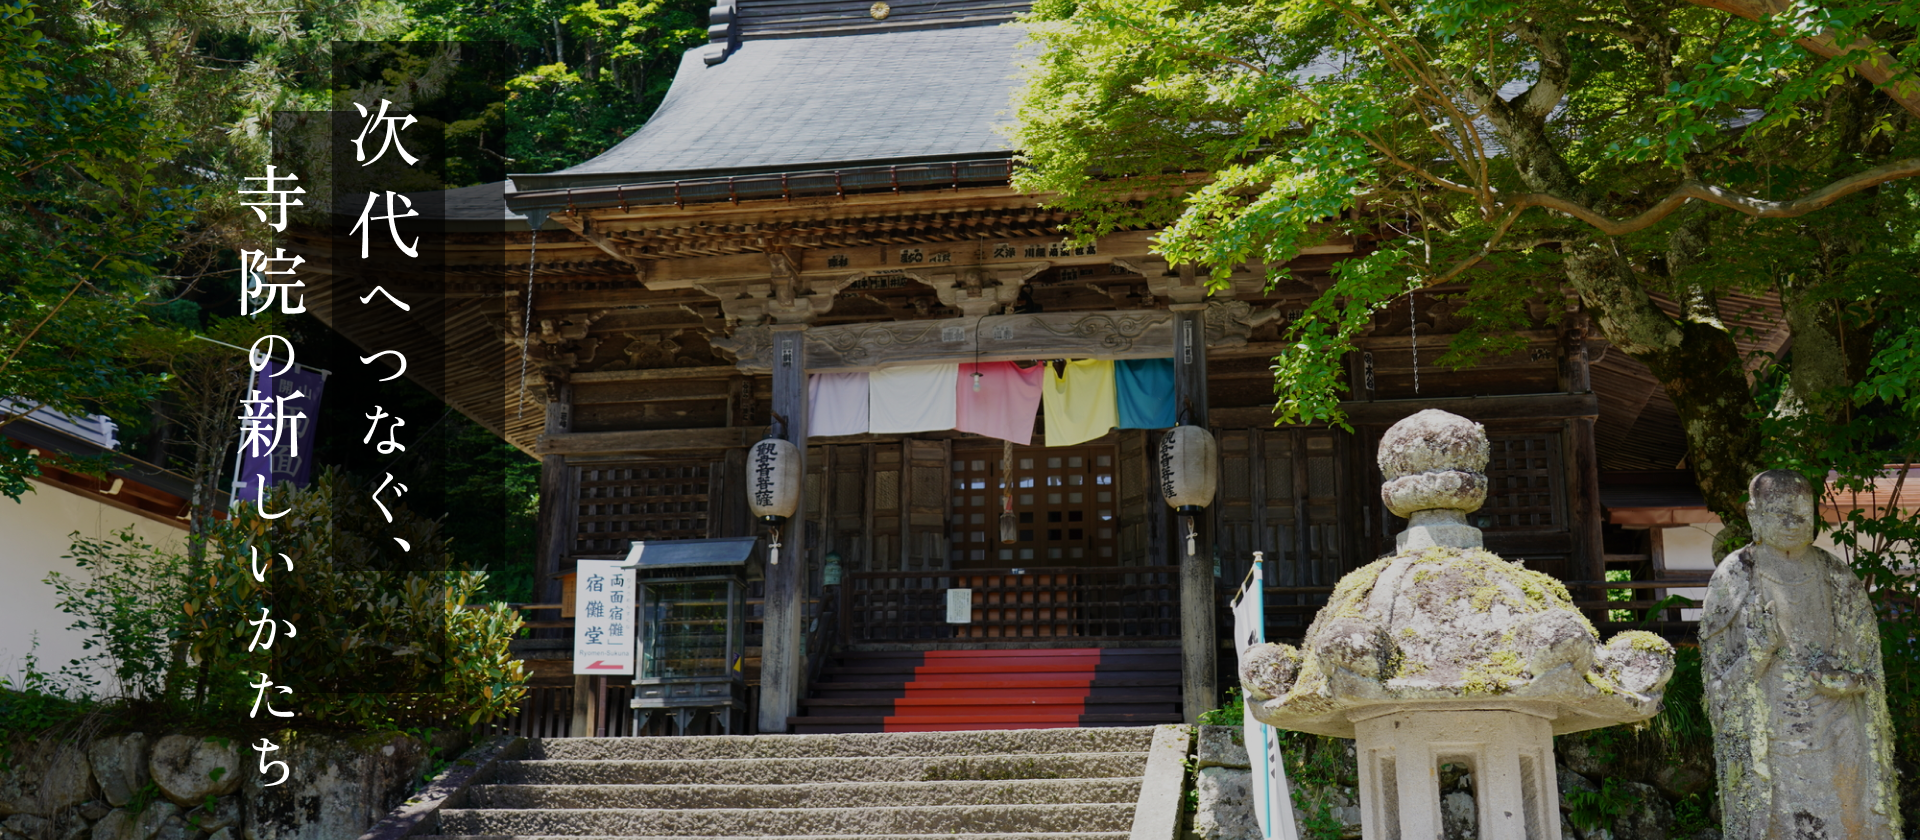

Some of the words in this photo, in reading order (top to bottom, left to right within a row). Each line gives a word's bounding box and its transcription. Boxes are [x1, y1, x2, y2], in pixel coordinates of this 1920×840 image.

[584, 572, 606, 646] 宿儺堂
[579, 649, 630, 660] Ryomen-Sukuna
